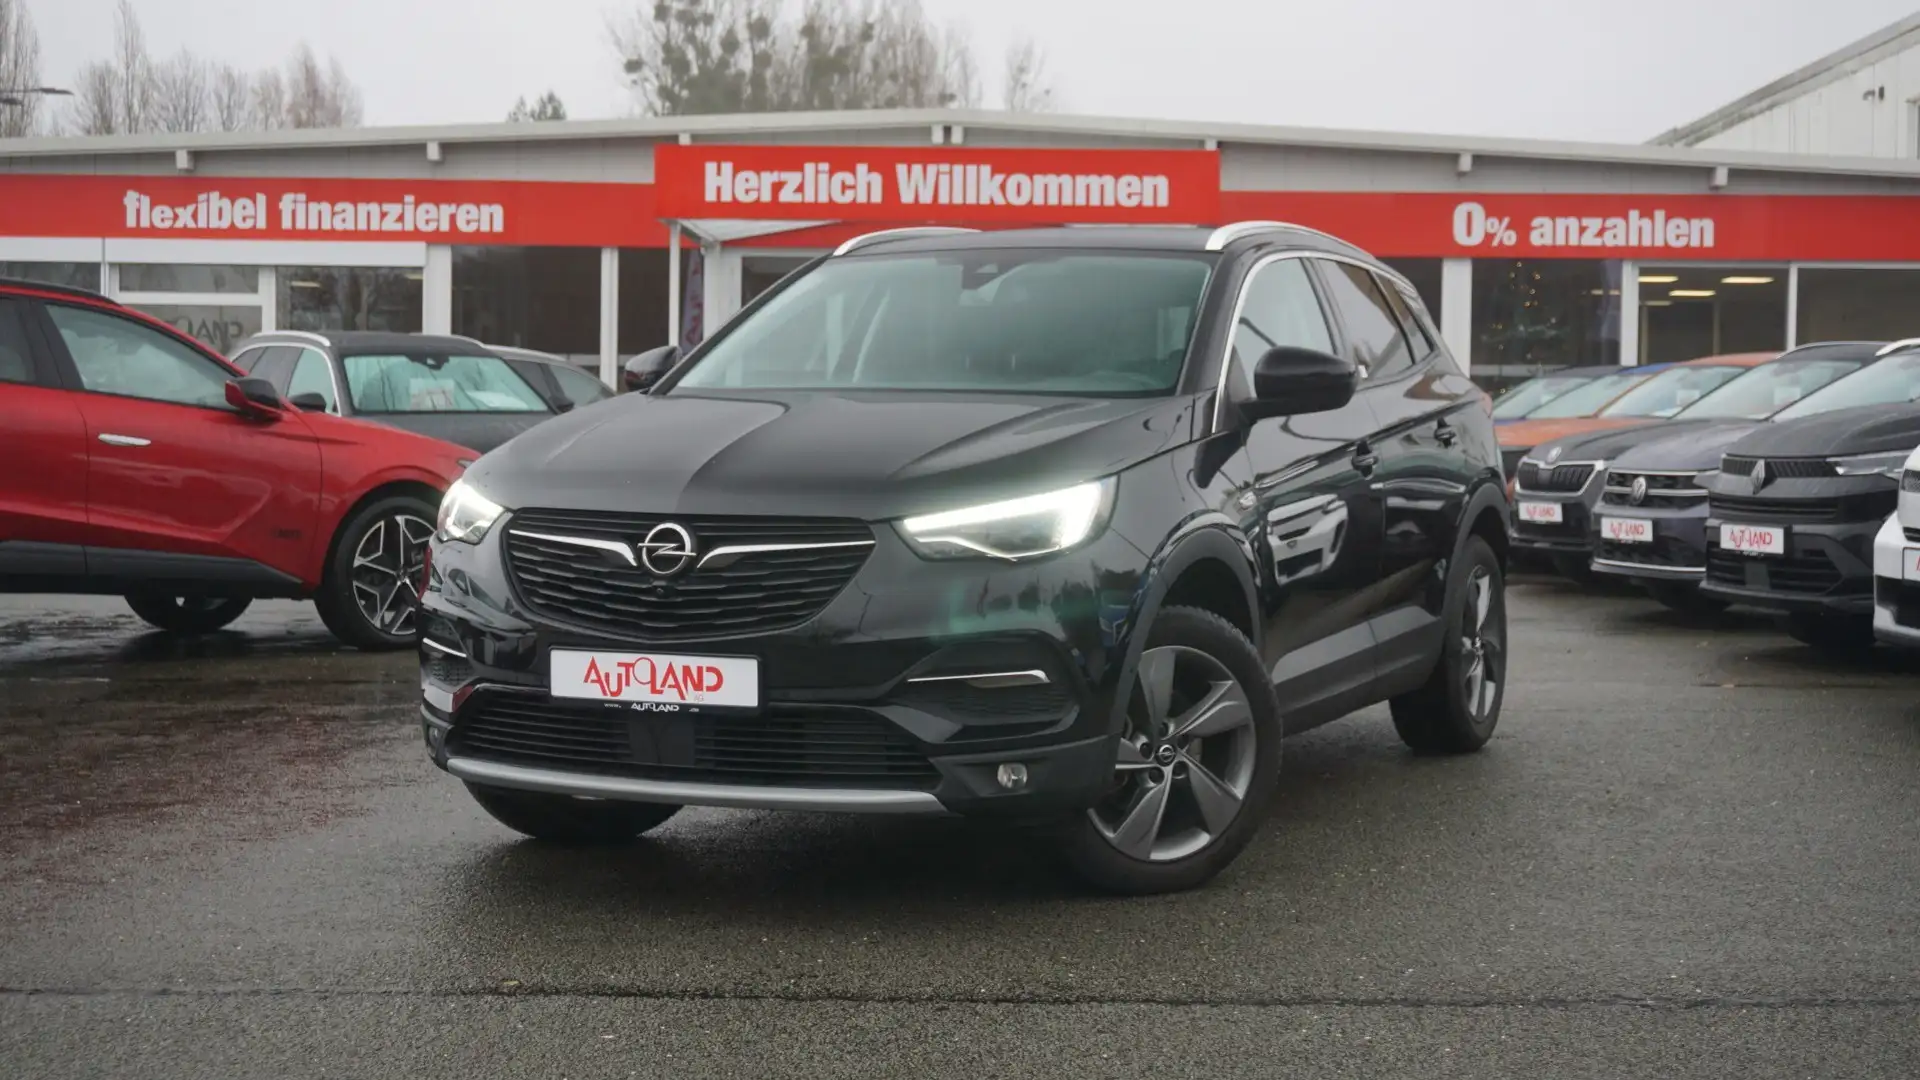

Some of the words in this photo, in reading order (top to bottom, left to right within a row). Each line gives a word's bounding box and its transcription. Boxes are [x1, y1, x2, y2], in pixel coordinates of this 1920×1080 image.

[704, 161, 883, 204] Herzlich
[895, 163, 1169, 208] Willkommen
[123, 190, 267, 230] flexibel
[279, 191, 504, 233] finanzieren
[1453, 202, 1517, 247] 0%
[1529, 209, 1715, 248] anzahlen
[583, 655, 724, 701] AUTOLAND
[631, 702, 680, 713] AUTOLAND
